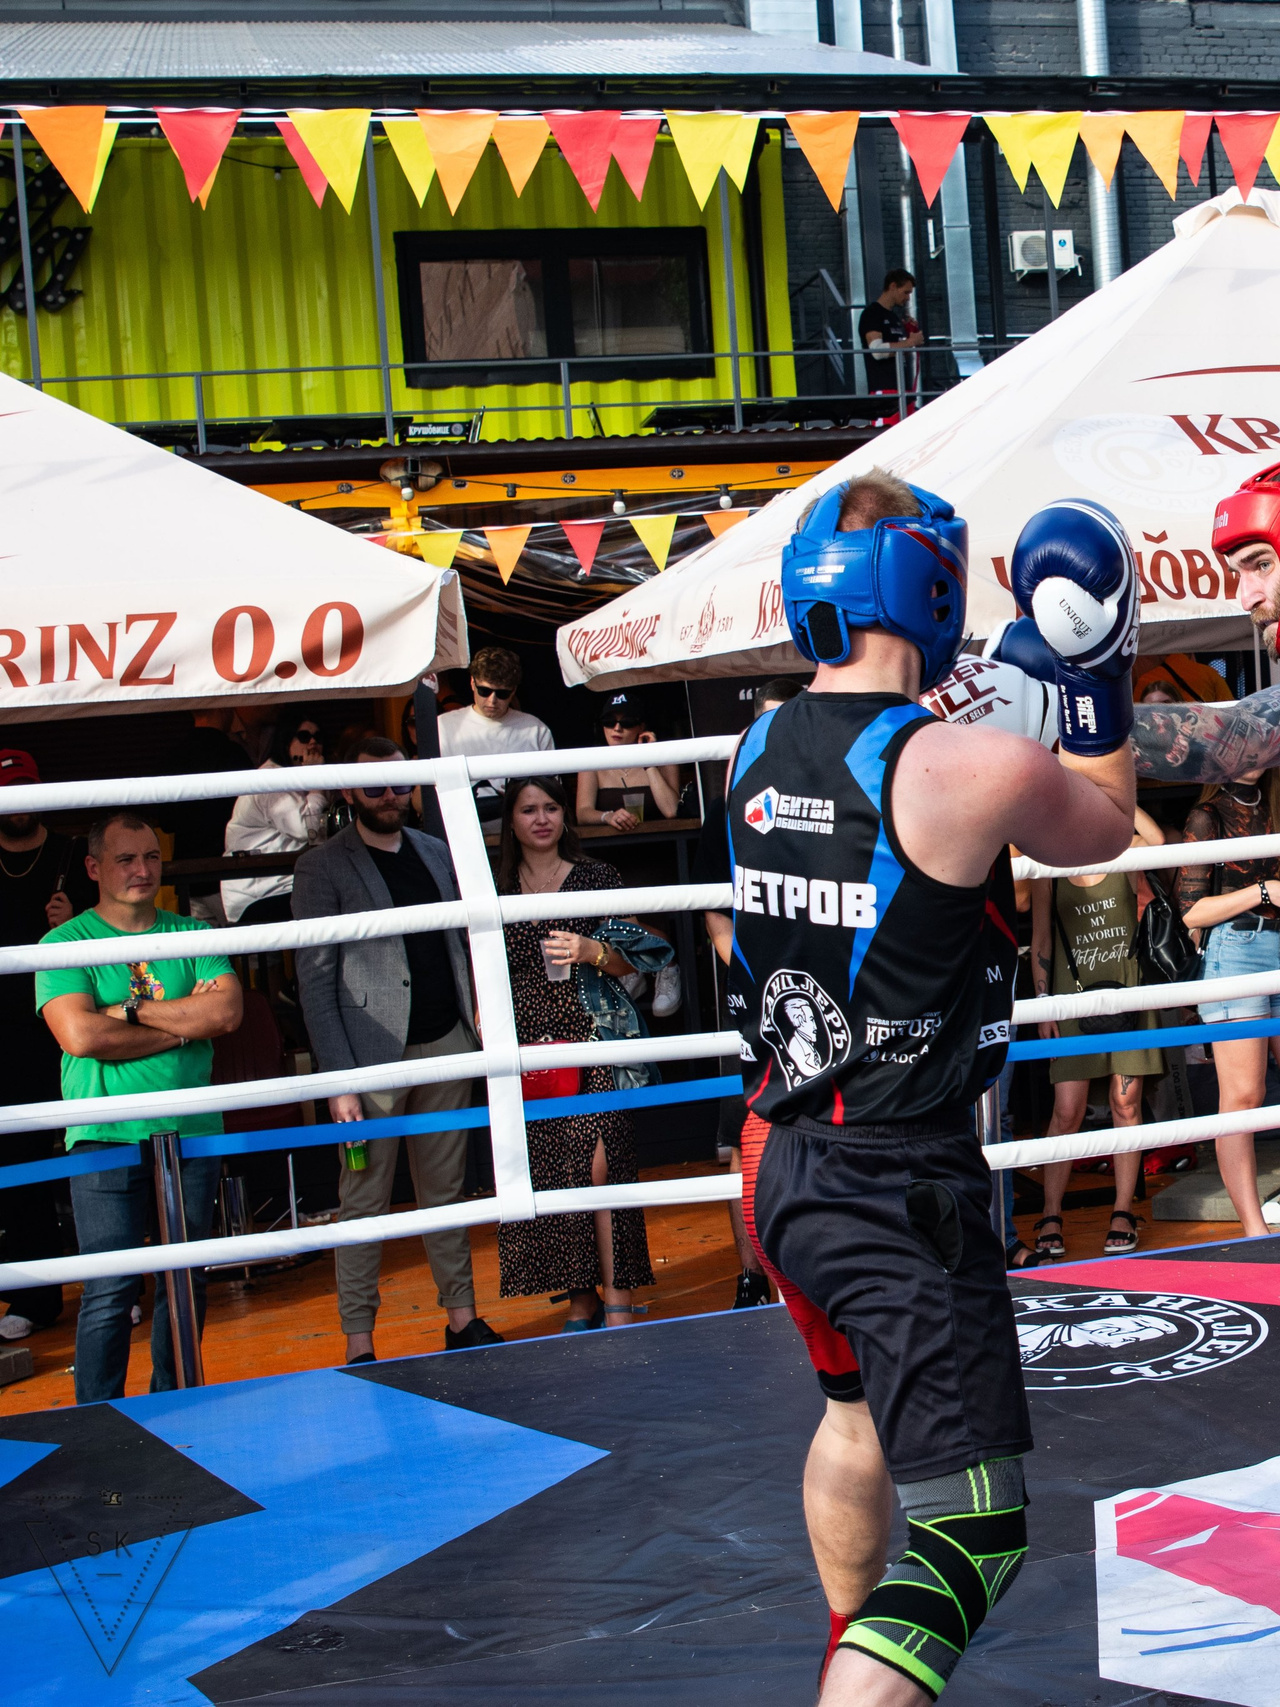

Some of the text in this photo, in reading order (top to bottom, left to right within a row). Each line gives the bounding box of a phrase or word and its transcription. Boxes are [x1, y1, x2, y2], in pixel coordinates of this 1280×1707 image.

[1058, 598, 1093, 637] UNIQUE
[970, 705, 986, 722] SELF
[1075, 697, 1086, 728] HILL
[1084, 695, 1097, 734] GREEN
[776, 794, 835, 821] БИТВА
[1075, 897, 1117, 916] YOU'RE
[1090, 914, 1106, 928] MY
[1076, 926, 1128, 945] FAVORITE
[1018, 1293, 1253, 1379] КАНЦЛЕРЪ
